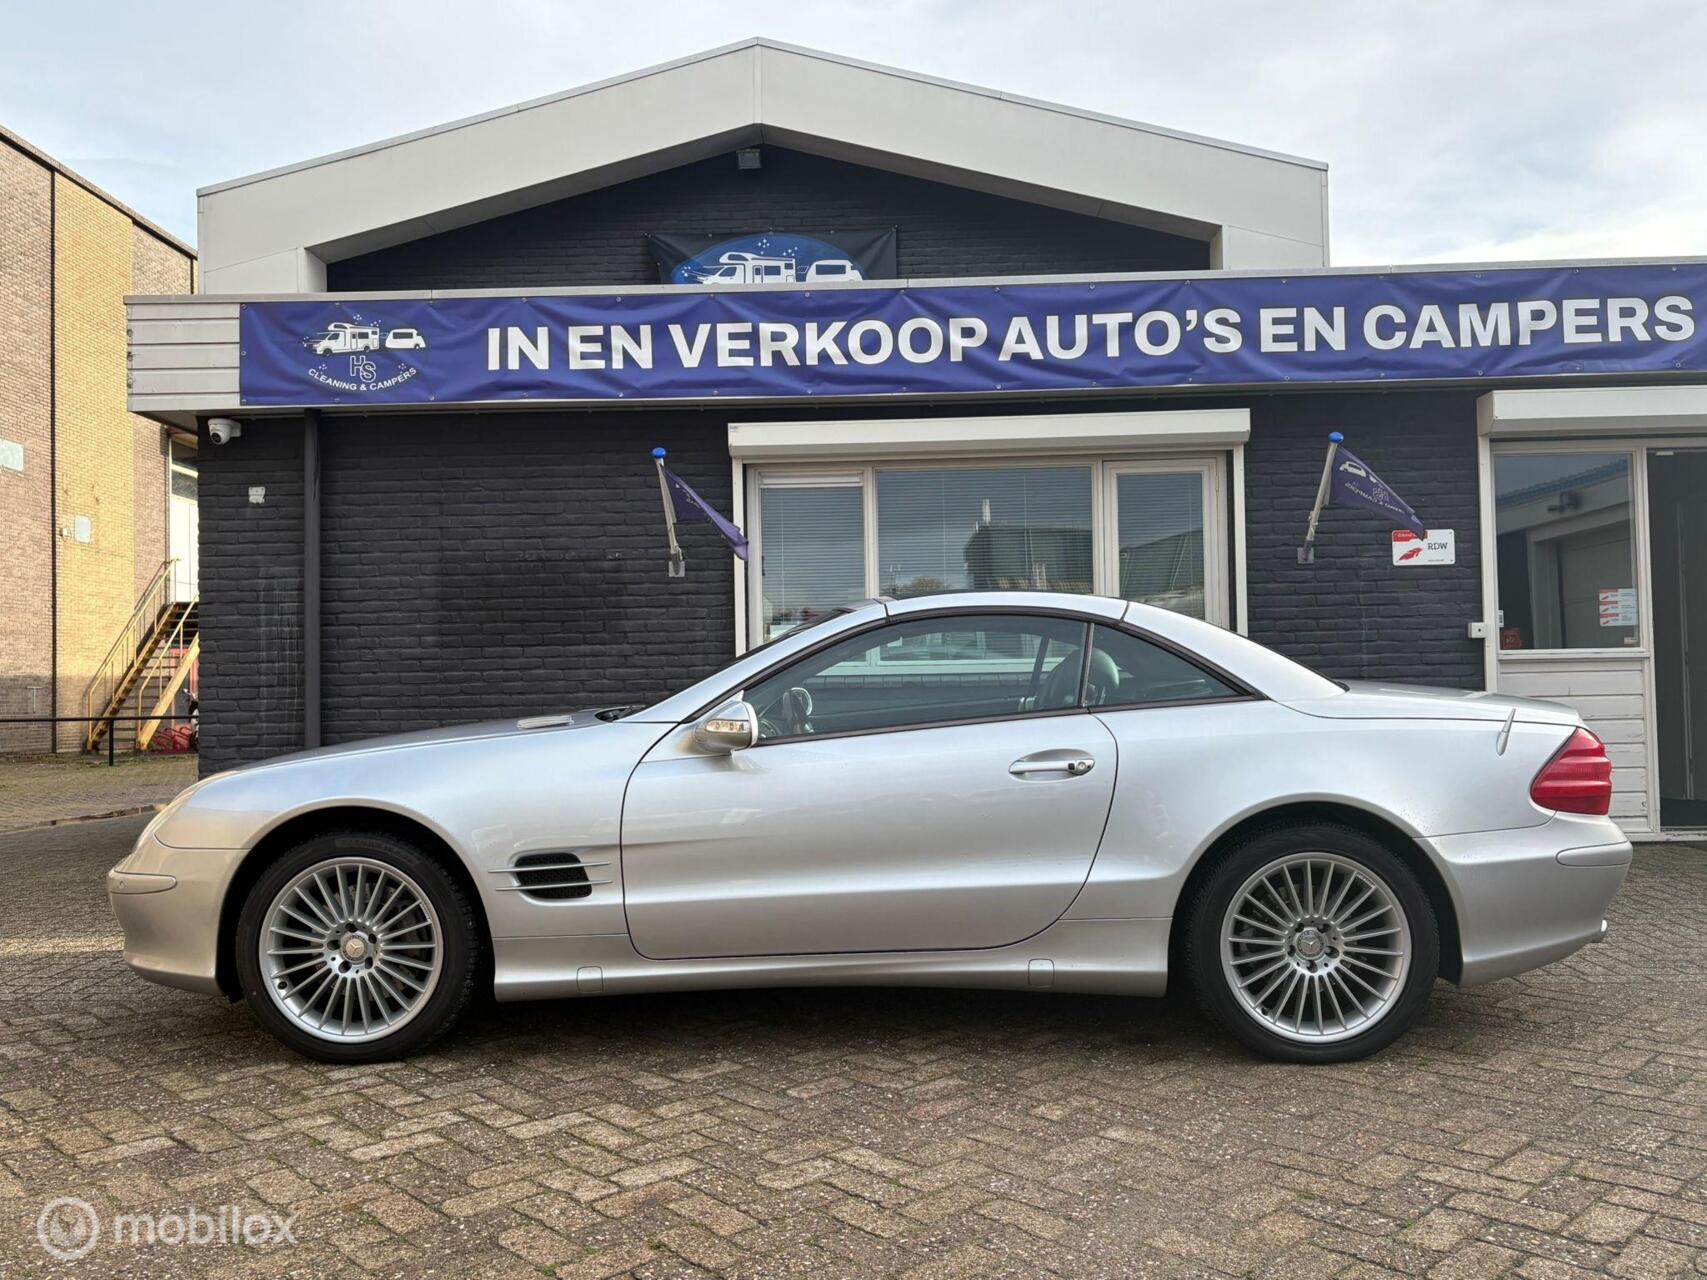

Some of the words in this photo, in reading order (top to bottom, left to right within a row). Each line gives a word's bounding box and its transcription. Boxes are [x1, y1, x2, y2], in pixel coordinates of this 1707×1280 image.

[487, 326, 550, 371] IN
[568, 324, 653, 370] EN
[667, 317, 988, 369] VERKOOP
[1259, 306, 1346, 353] EN
[1363, 295, 1695, 350] CAMPERS
[307, 367, 357, 391] CLEANING
[359, 382, 368, 391] &
[369, 367, 417, 391] CAMPERS
[350, 355, 377, 383] HS
[1427, 542, 1448, 551] RDW
